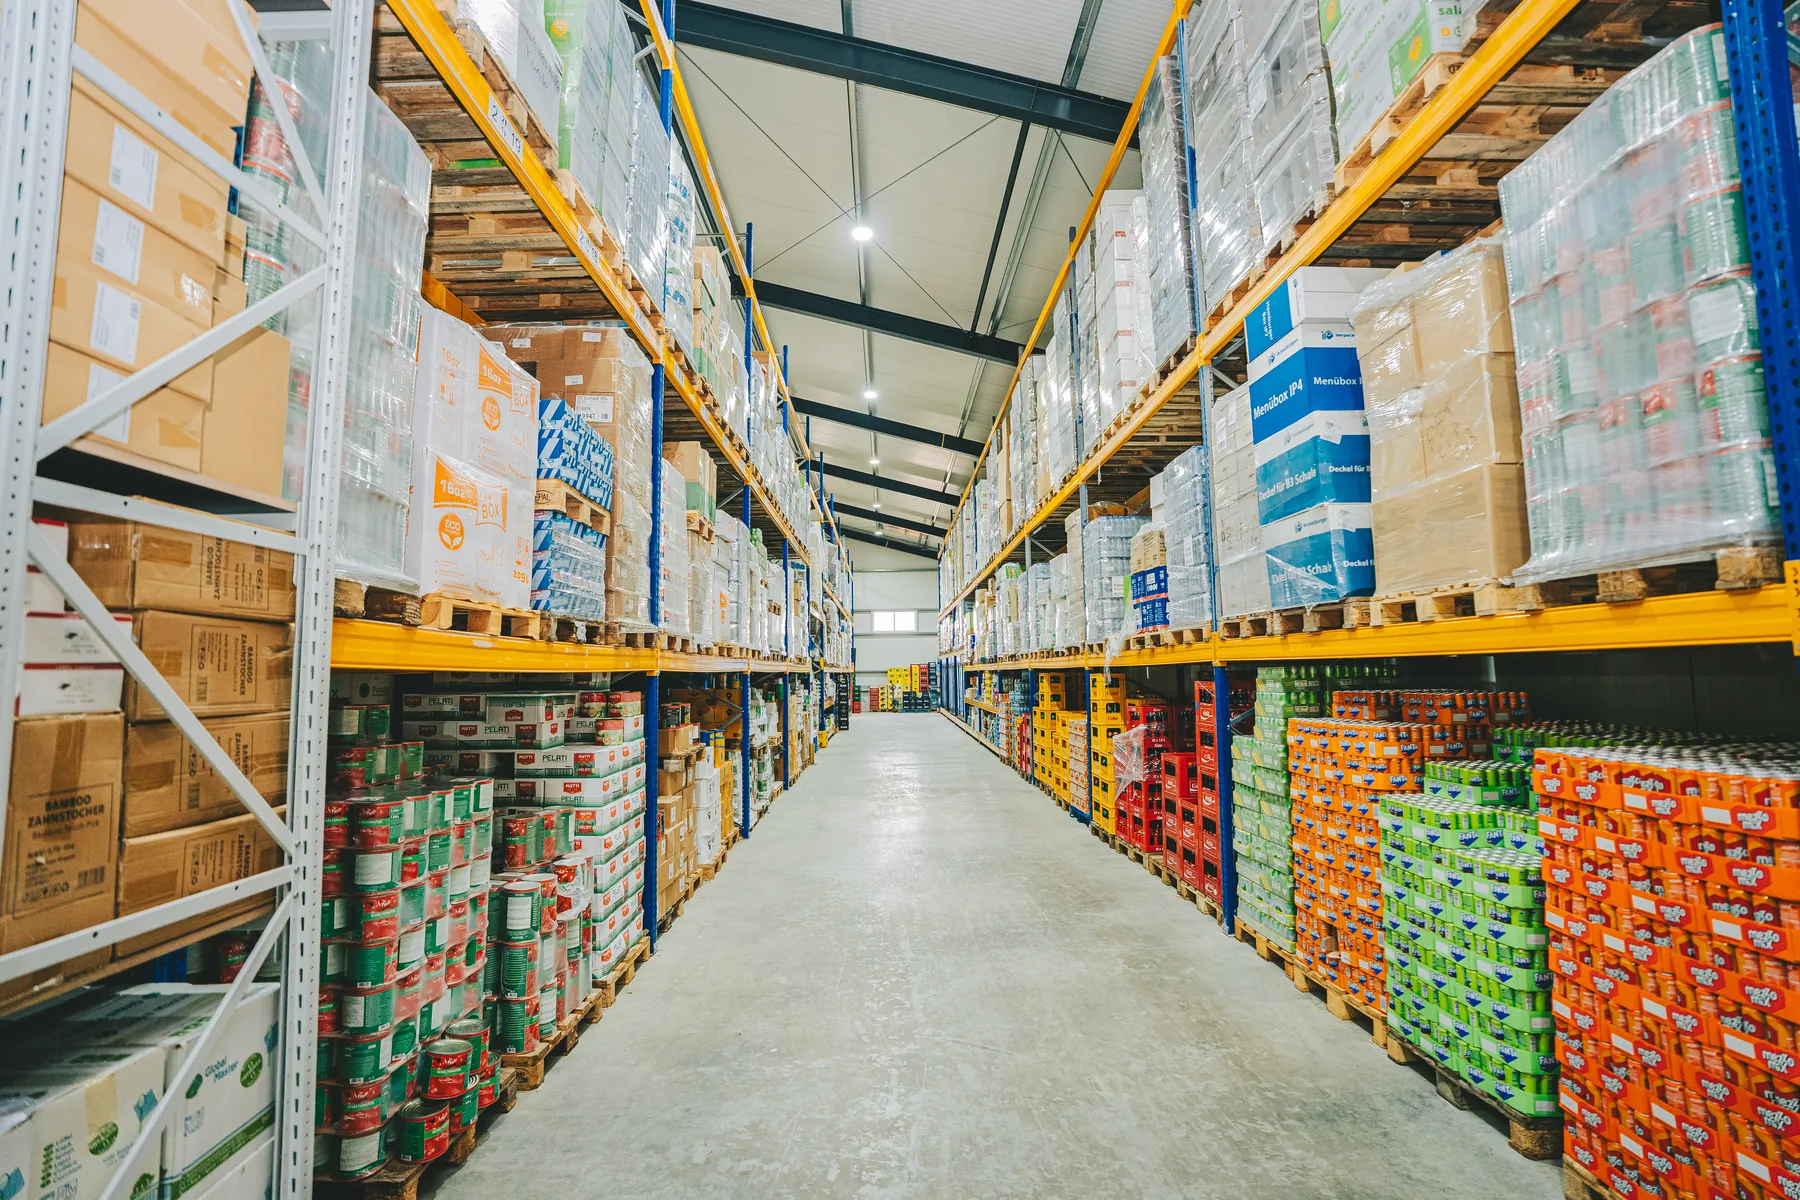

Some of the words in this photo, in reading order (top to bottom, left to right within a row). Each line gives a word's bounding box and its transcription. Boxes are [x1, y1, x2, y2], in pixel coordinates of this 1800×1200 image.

[482, 364, 502, 386] 16oz
[1313, 376, 1357, 385] Menübox
[514, 393, 529, 407] BOX
[1253, 391, 1288, 420] Menübox
[1289, 378, 1304, 397] IP4
[485, 402, 499, 414] ECO
[1328, 465, 1353, 473] Deckel
[440, 480, 465, 499] 16oz
[1258, 483, 1277, 502] Deckel
[1276, 481, 1285, 494] für
[1285, 478, 1294, 489] B3
[1295, 467, 1317, 486] Schale
[482, 503, 500, 519] BOX
[445, 520, 461, 531] ECO
[1401, 743, 1418, 752] FANTA
[45, 795, 91, 811] BAMBOO
[28, 804, 105, 828] ZAHNSTOCHER
[1737, 811, 1769, 823] mezzo
[1742, 820, 1762, 830] mix
[236, 834, 245, 881] ZAHNSTOC
[1680, 856, 1707, 868] mezzo
[1732, 867, 1764, 880] mezzo
[1737, 876, 1757, 886] mix
[1748, 929, 1780, 943] mezzo
[1753, 939, 1773, 950] mix
[1690, 967, 1719, 980] mezzo
[1695, 975, 1714, 987] mix
[1745, 985, 1778, 1001] mezzo
[1750, 995, 1771, 1008] mix
[1762, 1050, 1795, 1067] mezzo
[205, 1055, 228, 1077] Global
[213, 1061, 239, 1083] Master
[1768, 1060, 1788, 1074] mix
[1701, 1079, 1729, 1096] mezzo
[1706, 1089, 1725, 1102] mix
[1757, 1106, 1792, 1125] mezzo
[1682, 1122, 1709, 1140] mezzo
[1763, 1117, 1785, 1132] mix
